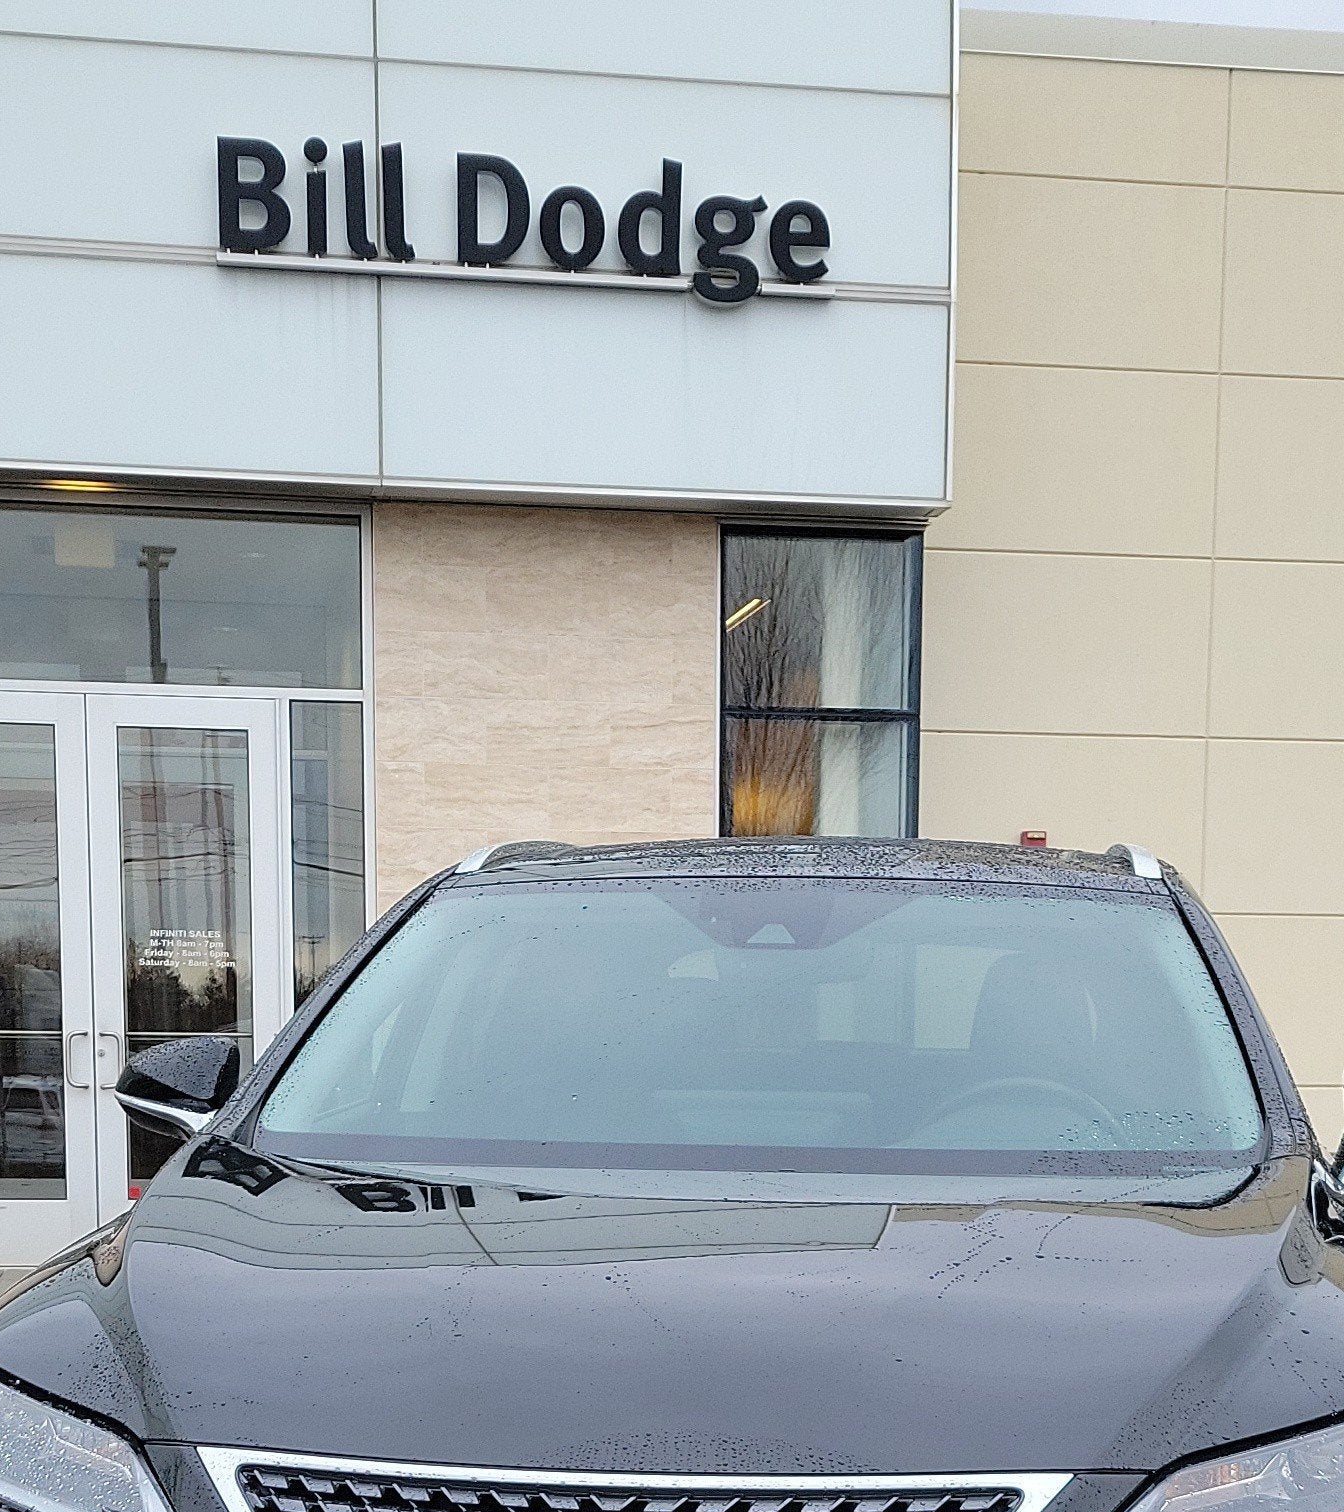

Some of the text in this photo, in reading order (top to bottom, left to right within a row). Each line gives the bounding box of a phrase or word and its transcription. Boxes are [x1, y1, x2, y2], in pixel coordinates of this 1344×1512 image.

[216, 135, 831, 303] Bill Dodge
[150, 929, 221, 938] INFINITI SALES
[150, 939, 174, 947] M-TH
[204, 940, 224, 949] 7pm
[144, 948, 174, 958] Friday
[138, 957, 180, 968] Saturday
